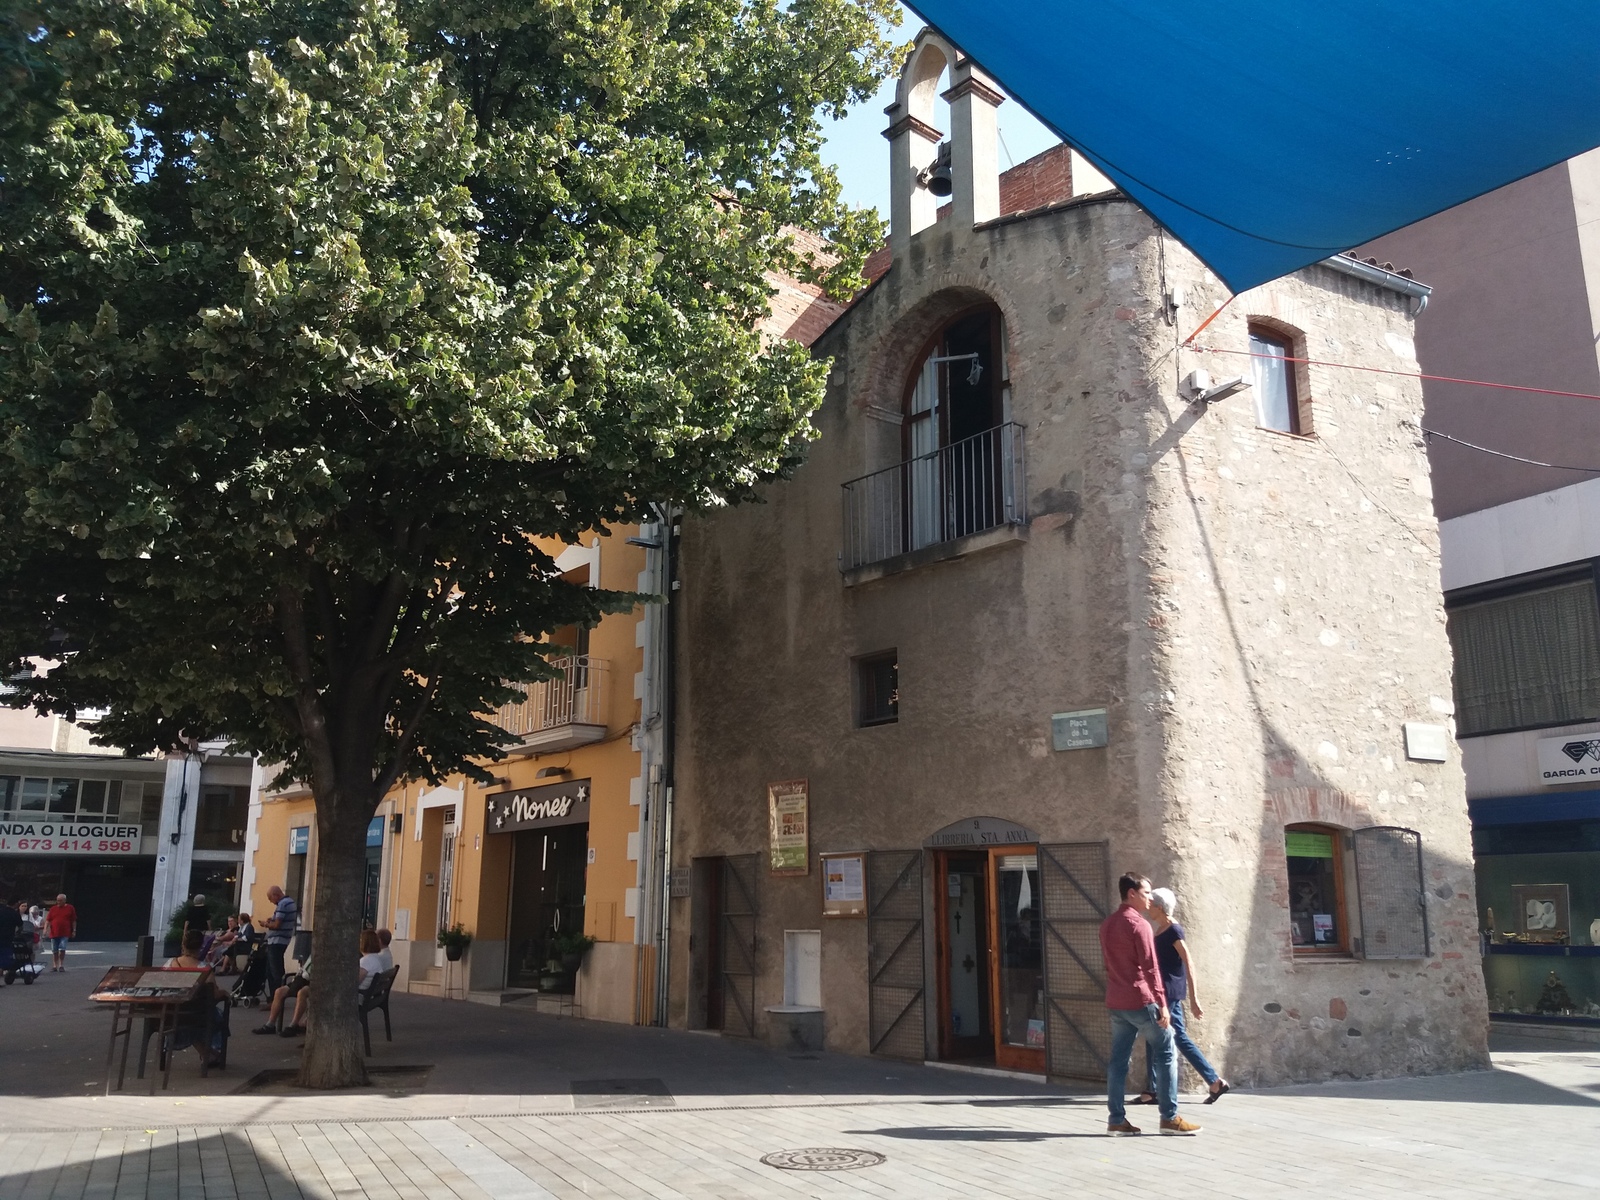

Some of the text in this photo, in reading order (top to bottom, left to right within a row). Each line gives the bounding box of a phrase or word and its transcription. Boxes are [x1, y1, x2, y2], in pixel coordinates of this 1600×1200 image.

[1071, 729, 1080, 737] de
[1543, 769, 1586, 779] GARCIA
[512, 794, 571, 823] Nones
[40, 825, 54, 836] O
[60, 825, 138, 838] LLOGUER
[931, 829, 1030, 847] LLIBRERIA STA ANNA
[18, 839, 53, 851] 673
[58, 840, 92, 851] 414
[98, 840, 131, 852] 598
